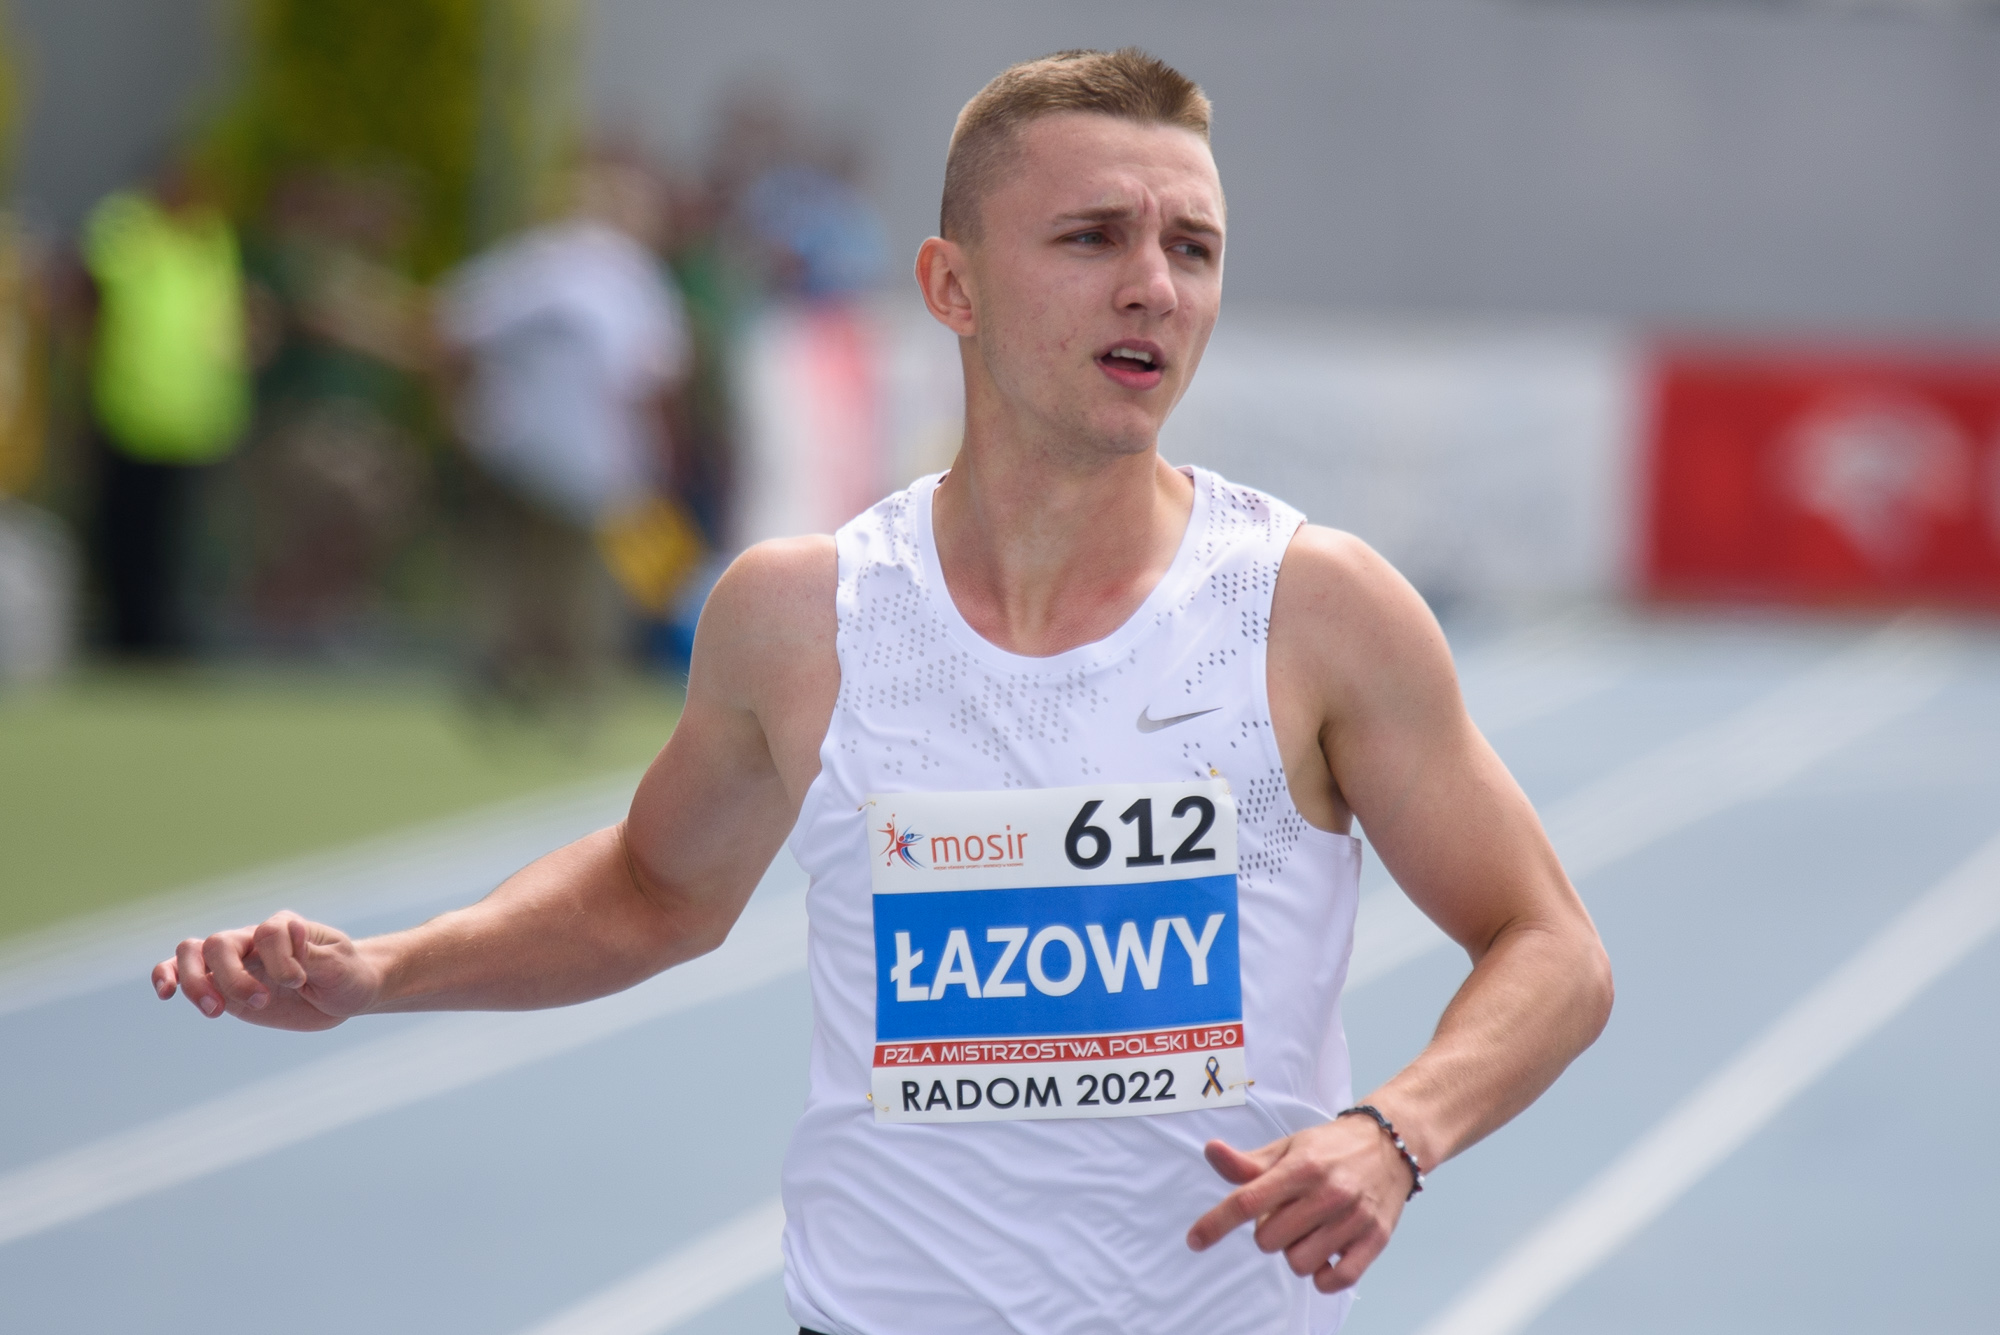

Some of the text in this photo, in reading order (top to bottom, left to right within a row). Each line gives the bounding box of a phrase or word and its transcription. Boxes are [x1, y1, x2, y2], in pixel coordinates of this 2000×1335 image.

[930, 825, 1028, 863] mosir
[1064, 795, 1217, 870] 612
[890, 913, 1226, 1003] ŁAZOWY
[883, 1029, 1238, 1065] PZLA MISTRZOSTWA POLSKI U20
[901, 1068, 1177, 1113] RADOM 2022
